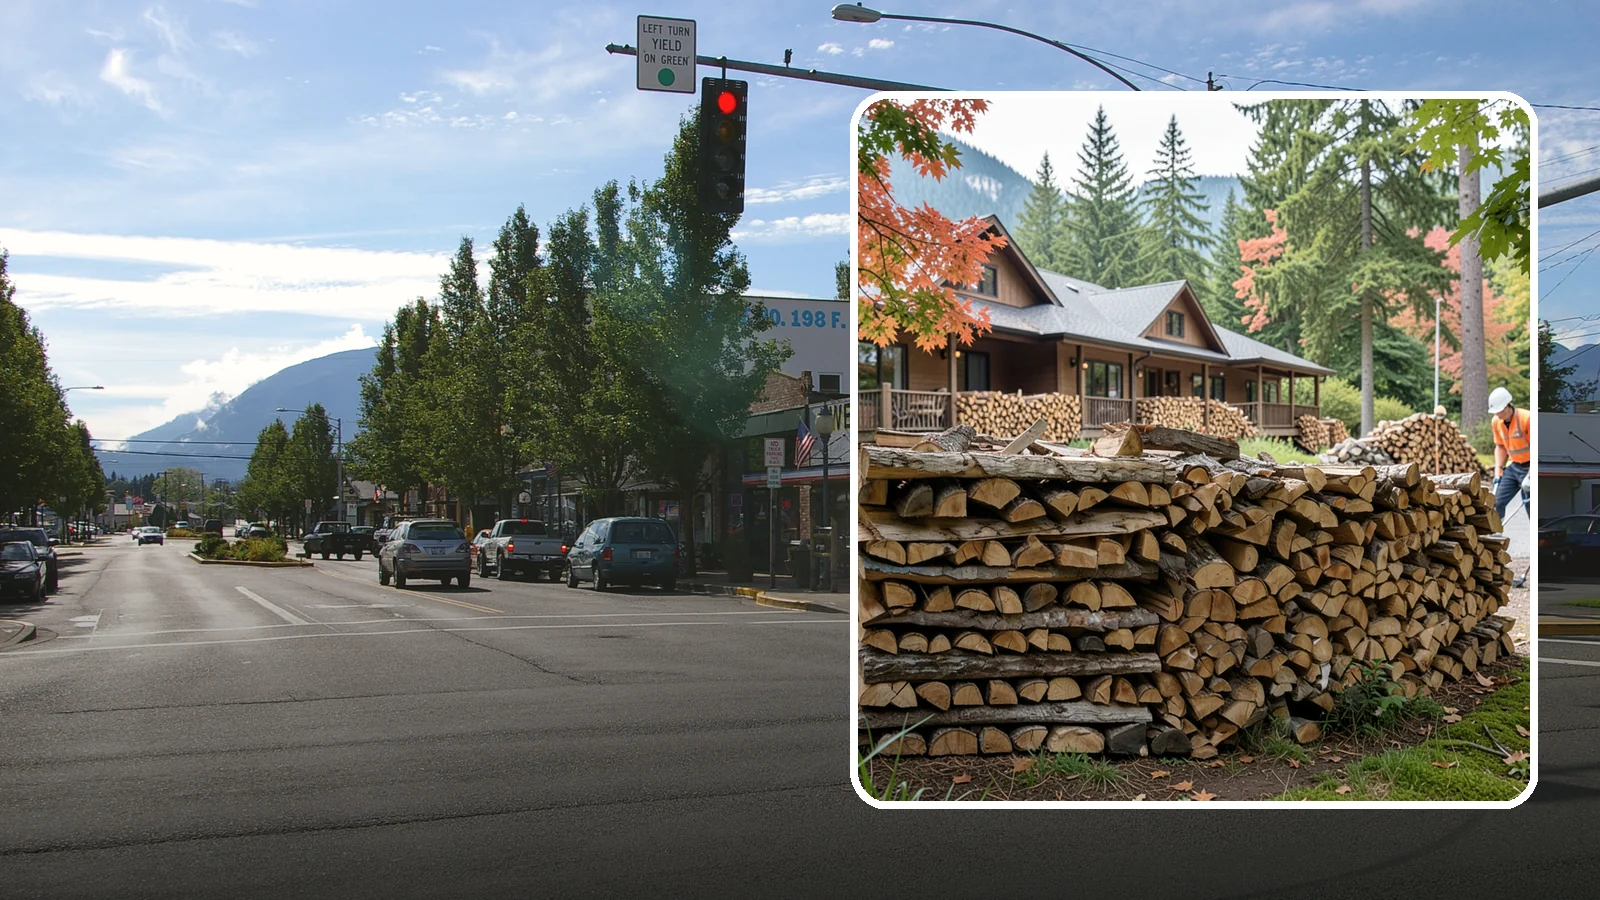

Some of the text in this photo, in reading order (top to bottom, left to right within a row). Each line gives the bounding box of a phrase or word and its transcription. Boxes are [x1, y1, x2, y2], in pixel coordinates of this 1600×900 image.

[643, 24, 690, 36] LEFT TURN
[652, 38, 682, 52] YIELD
[644, 54, 690, 66] ON GREEN
[791, 310, 826, 328] 198
[831, 311, 847, 329] F.
